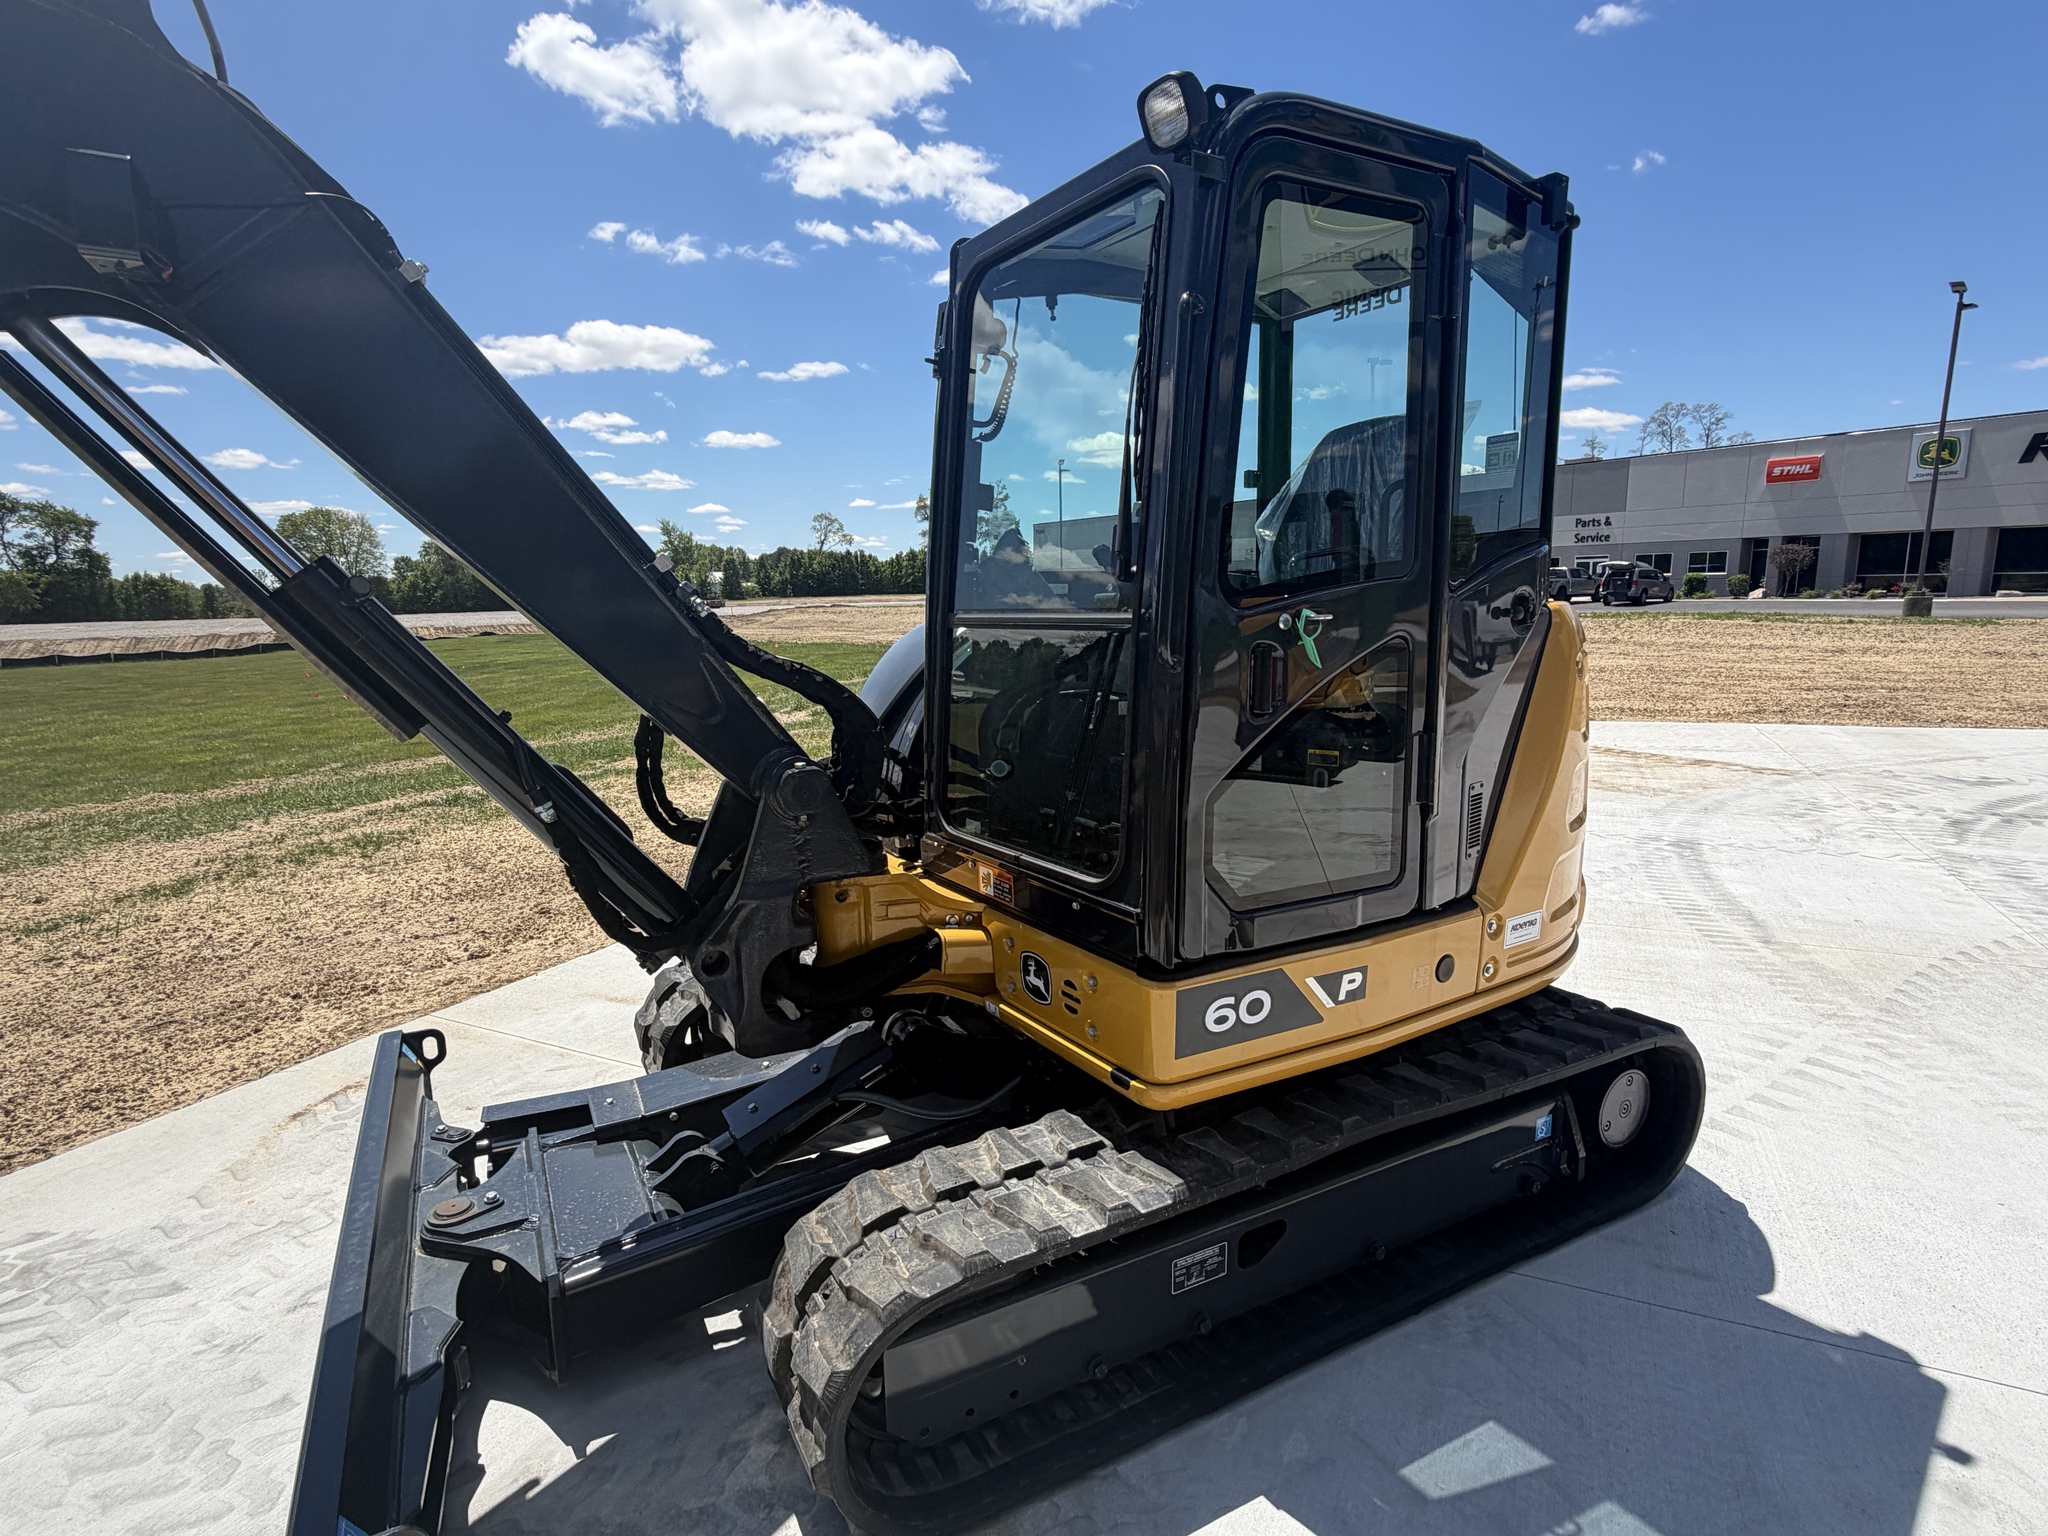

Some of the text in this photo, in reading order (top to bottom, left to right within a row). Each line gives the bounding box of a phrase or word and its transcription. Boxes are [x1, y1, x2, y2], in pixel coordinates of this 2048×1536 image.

[1771, 464, 1814, 477] STIHL
[1575, 515, 1613, 529] Parts &
[1574, 531, 1611, 544] Service
[1204, 989, 1272, 1033] 60
